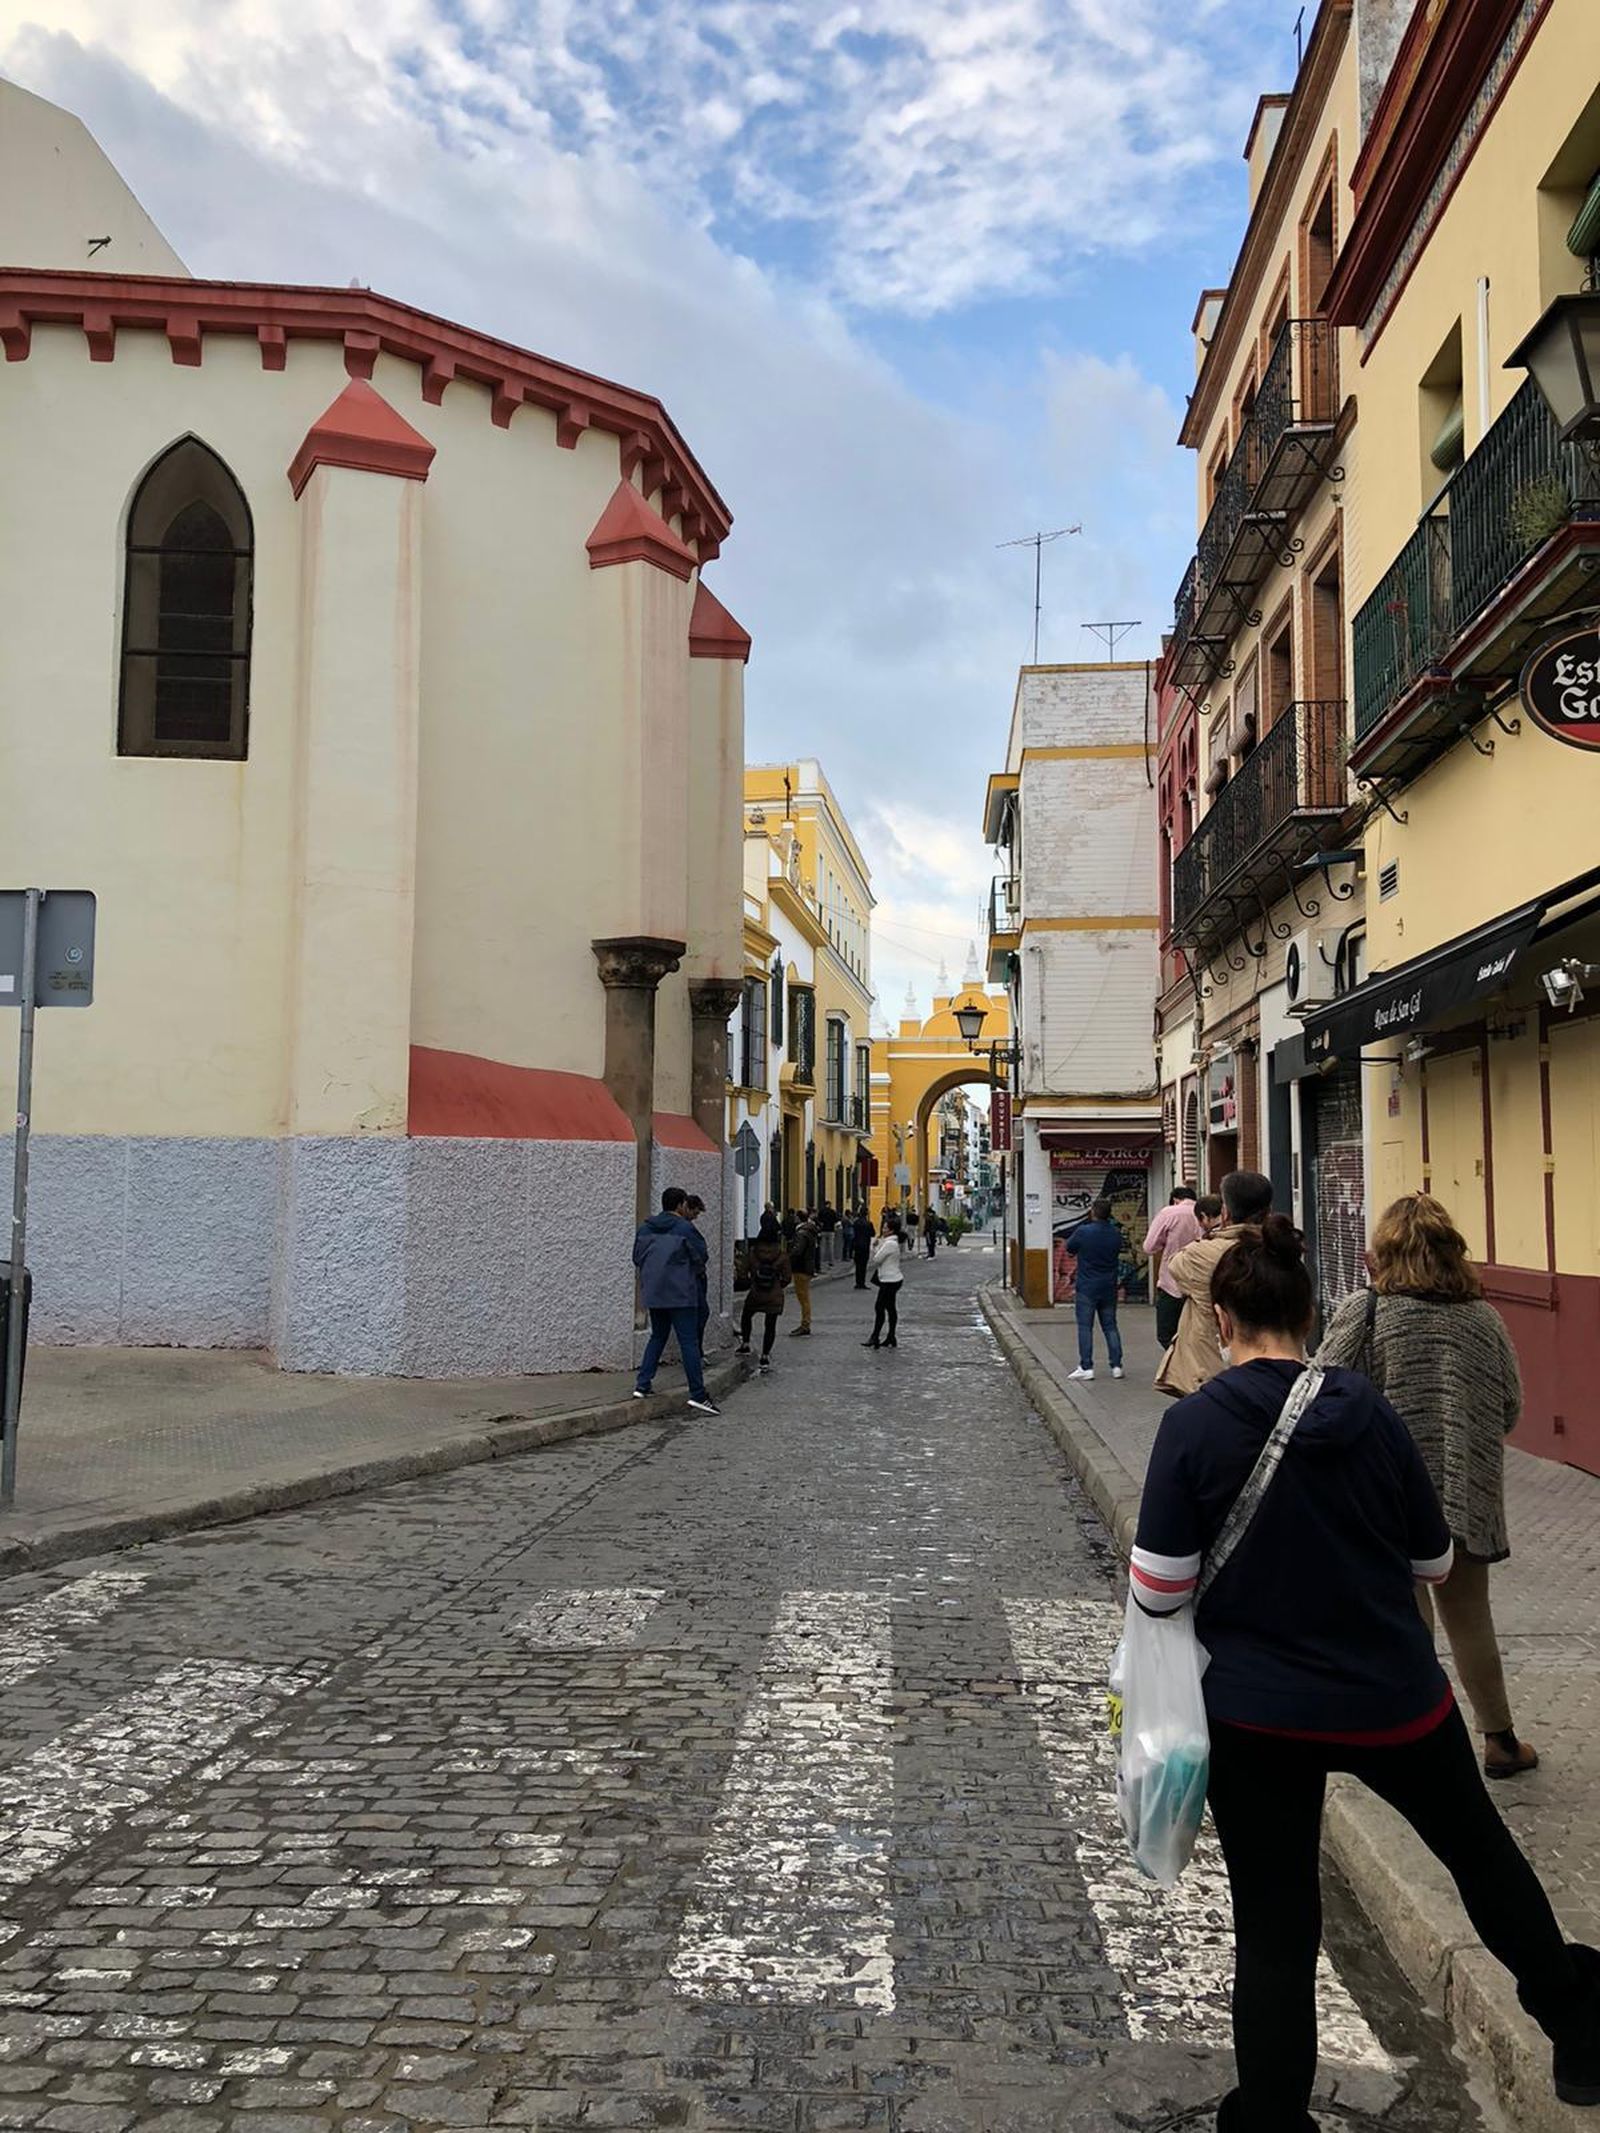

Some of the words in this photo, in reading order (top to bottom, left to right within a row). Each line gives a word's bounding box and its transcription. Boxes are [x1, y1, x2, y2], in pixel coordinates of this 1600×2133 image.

[1374, 1009, 1389, 1030] Rosa
[1389, 1000, 1397, 1022] de
[1397, 1000, 1409, 1021] San
[1410, 988, 1421, 1022] Gil
[1105, 1147, 1150, 1158] ARCO
